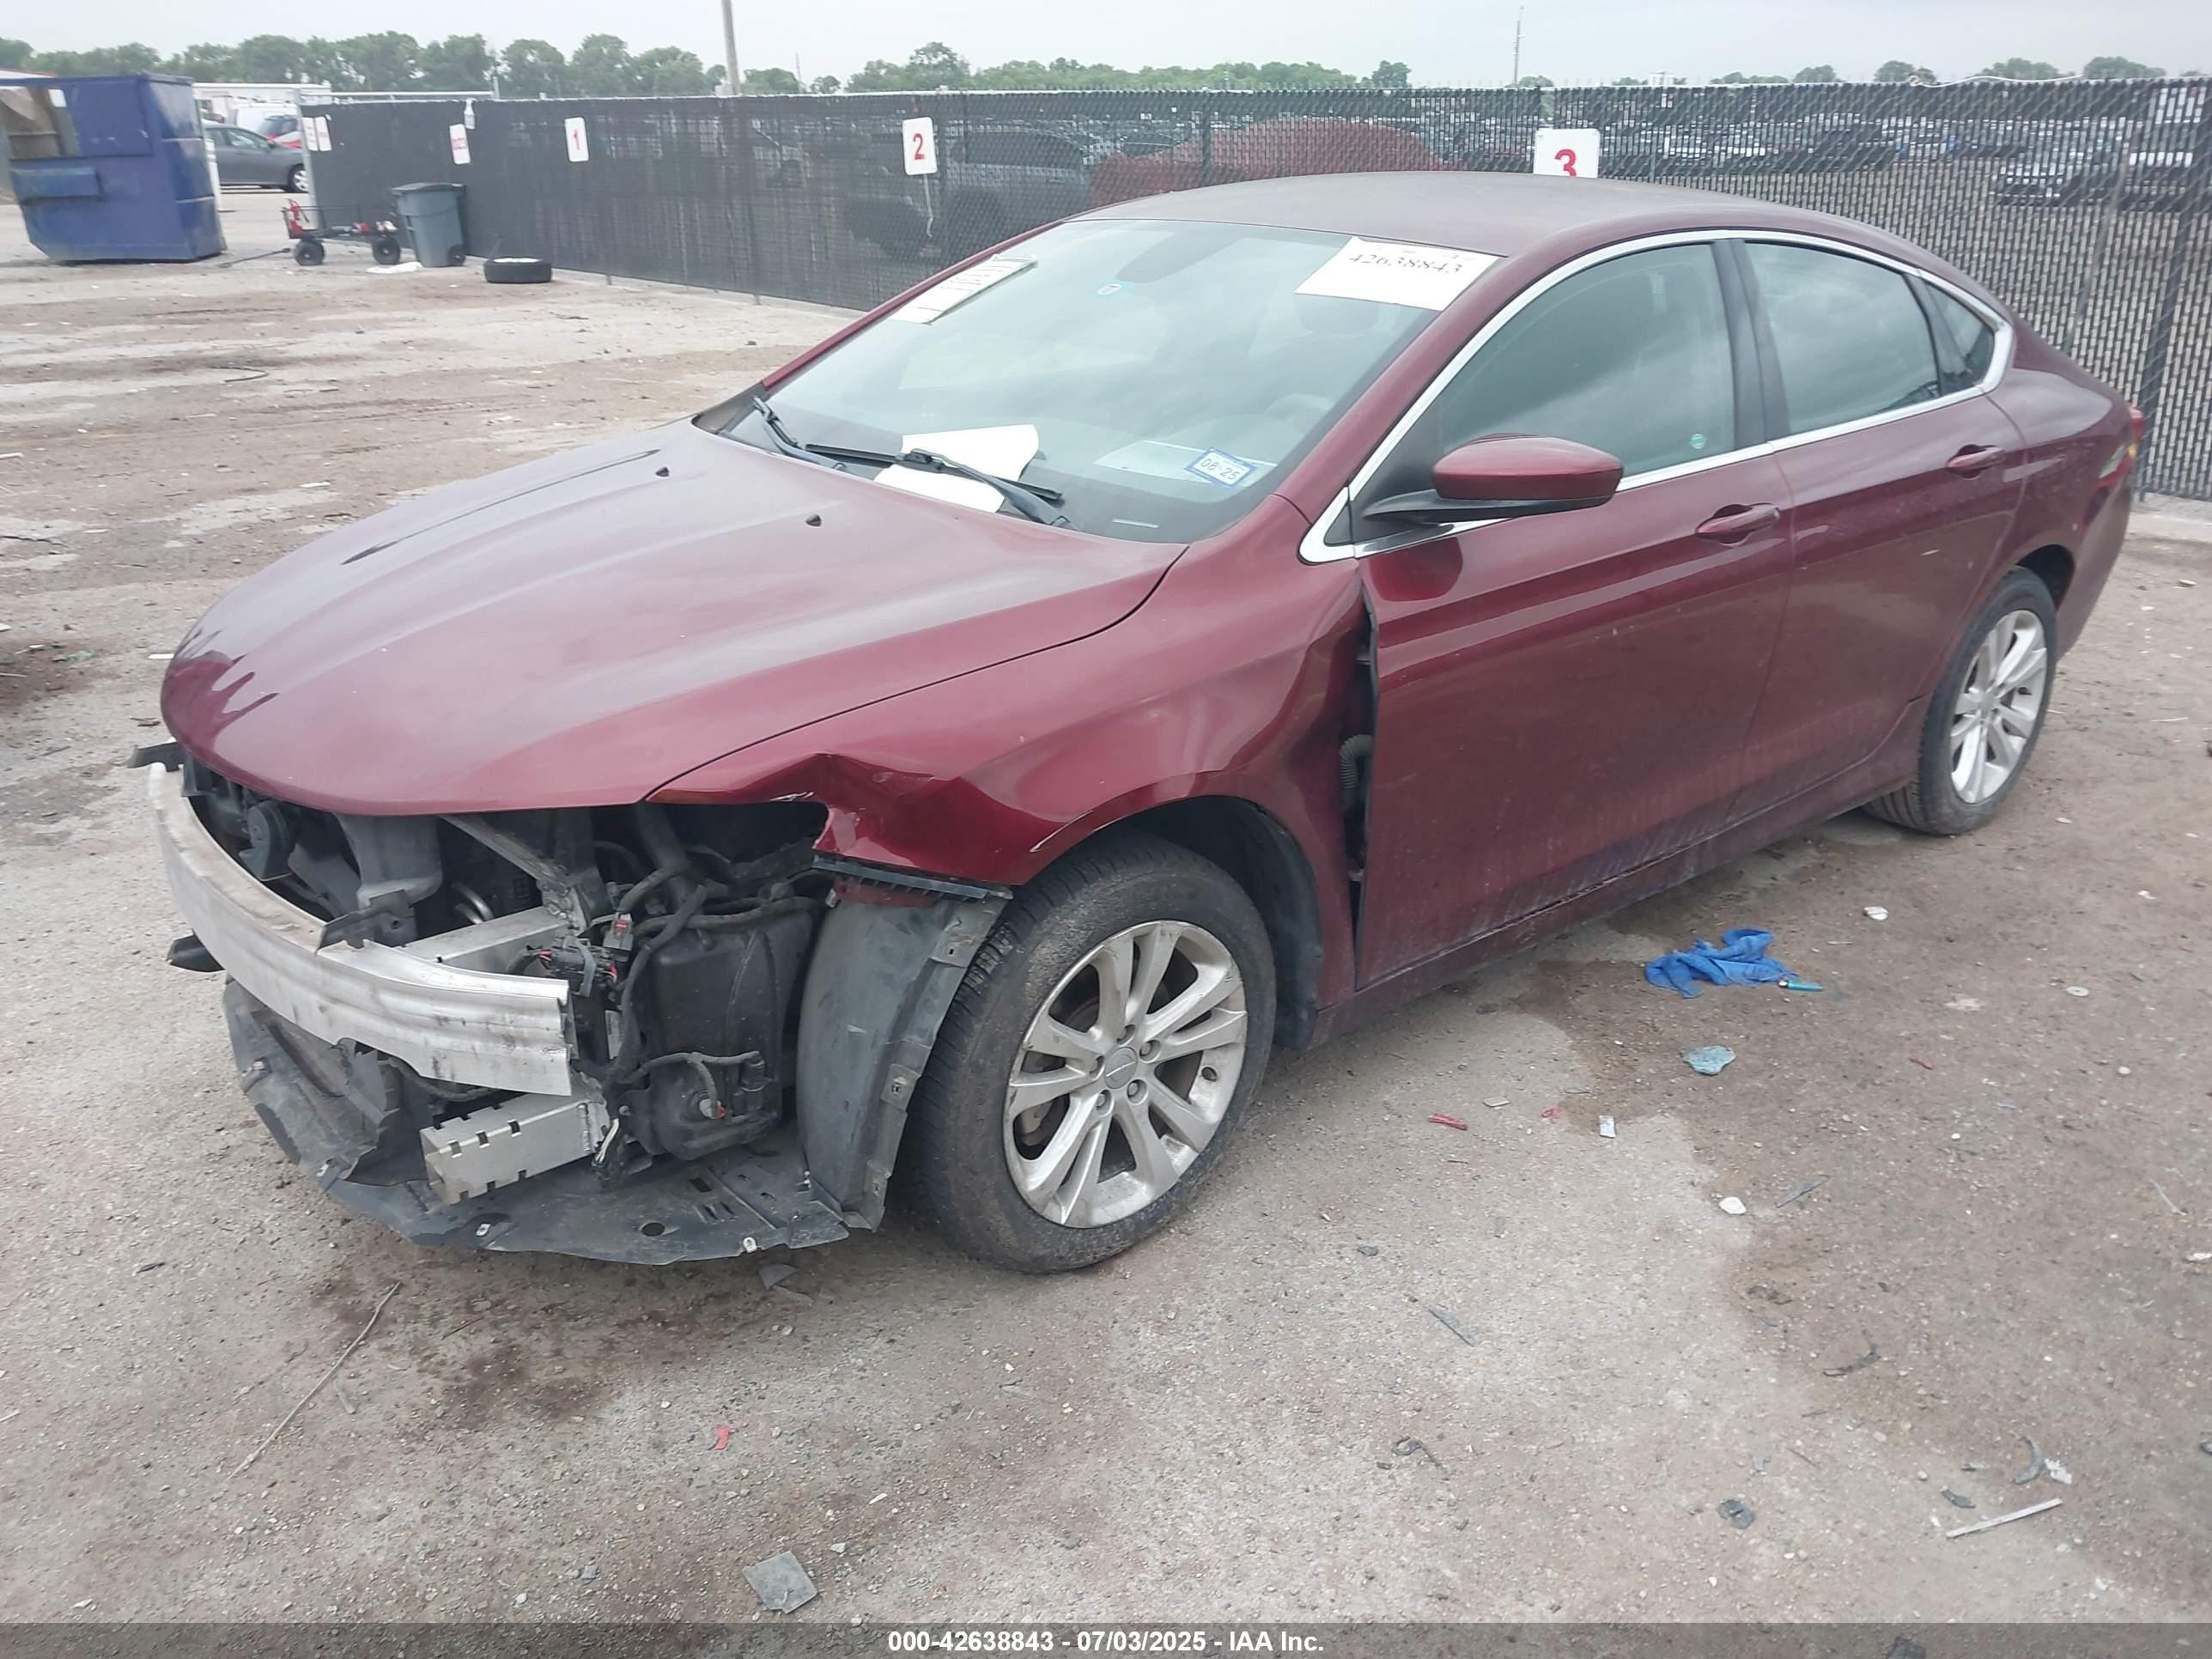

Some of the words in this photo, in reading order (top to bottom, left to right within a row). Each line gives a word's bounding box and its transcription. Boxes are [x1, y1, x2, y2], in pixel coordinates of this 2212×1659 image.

[913, 132, 926, 161] 2
[1554, 149, 1577, 177] 3
[1347, 253, 1463, 274] 42638843
